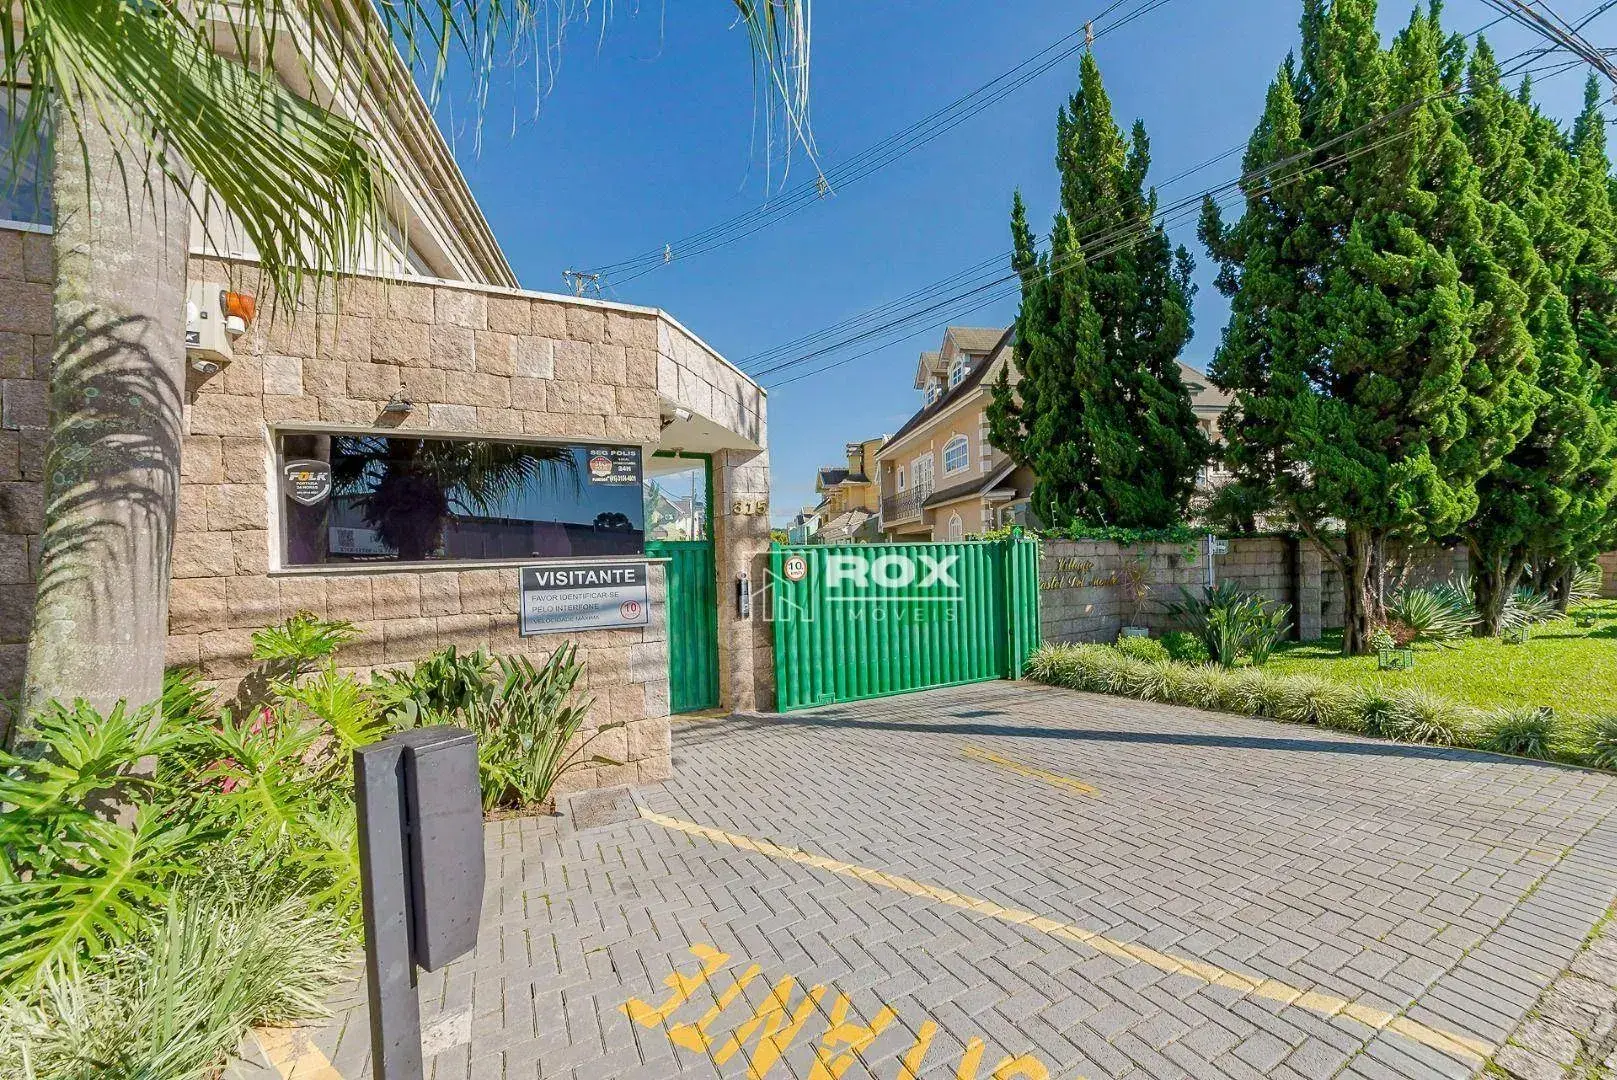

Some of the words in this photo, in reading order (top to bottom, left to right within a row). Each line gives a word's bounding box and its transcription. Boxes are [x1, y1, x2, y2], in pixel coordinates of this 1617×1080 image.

[288, 472, 328, 481] FOLK
[732, 501, 767, 515] 315
[788, 561, 802, 570] 10
[535, 569, 636, 587] VISITANTE
[532, 594, 560, 602] FAVOR
[532, 605, 554, 613] PELO
[555, 603, 600, 612] INTERFONE
[624, 602, 637, 612] 10
